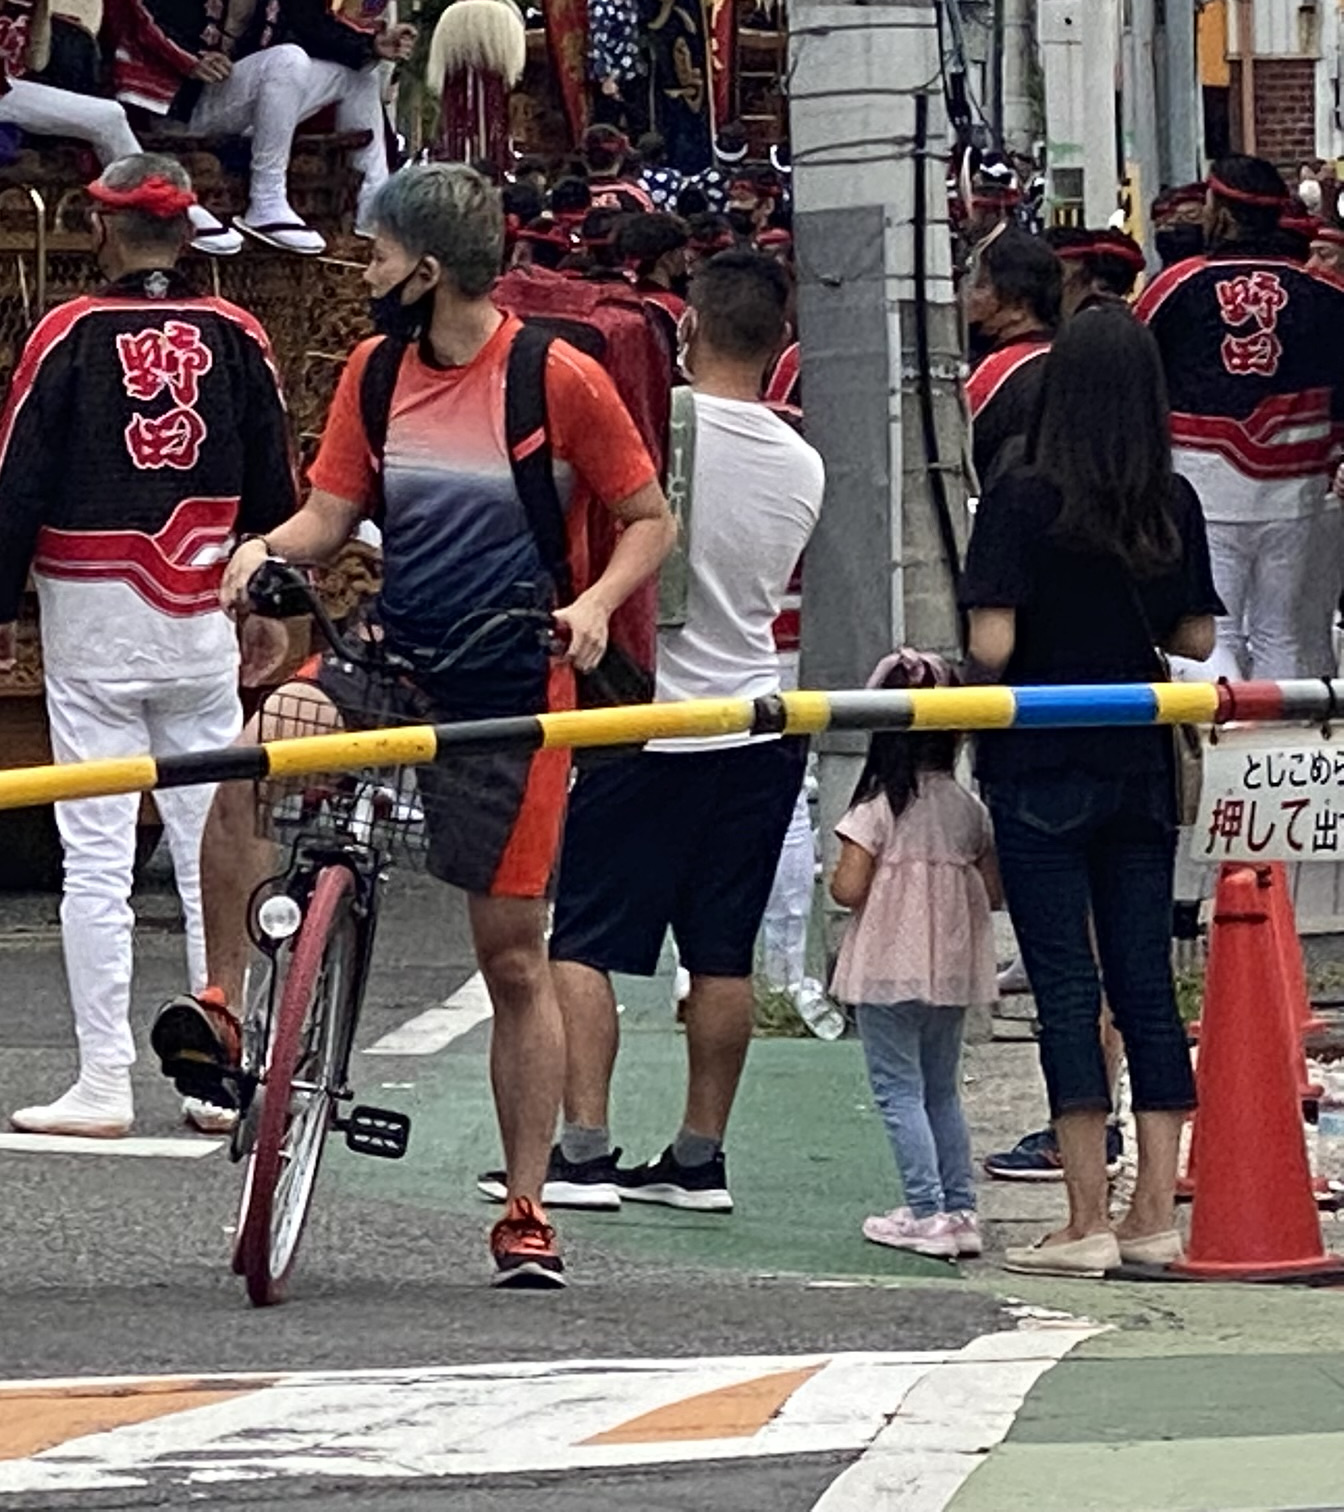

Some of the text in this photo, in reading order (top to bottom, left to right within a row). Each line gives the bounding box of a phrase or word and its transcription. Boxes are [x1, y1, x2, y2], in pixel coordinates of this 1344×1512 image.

[1216, 271, 1289, 377] 野田
[116, 320, 213, 470] 野田
[1205, 798, 1344, 854] 押して出
